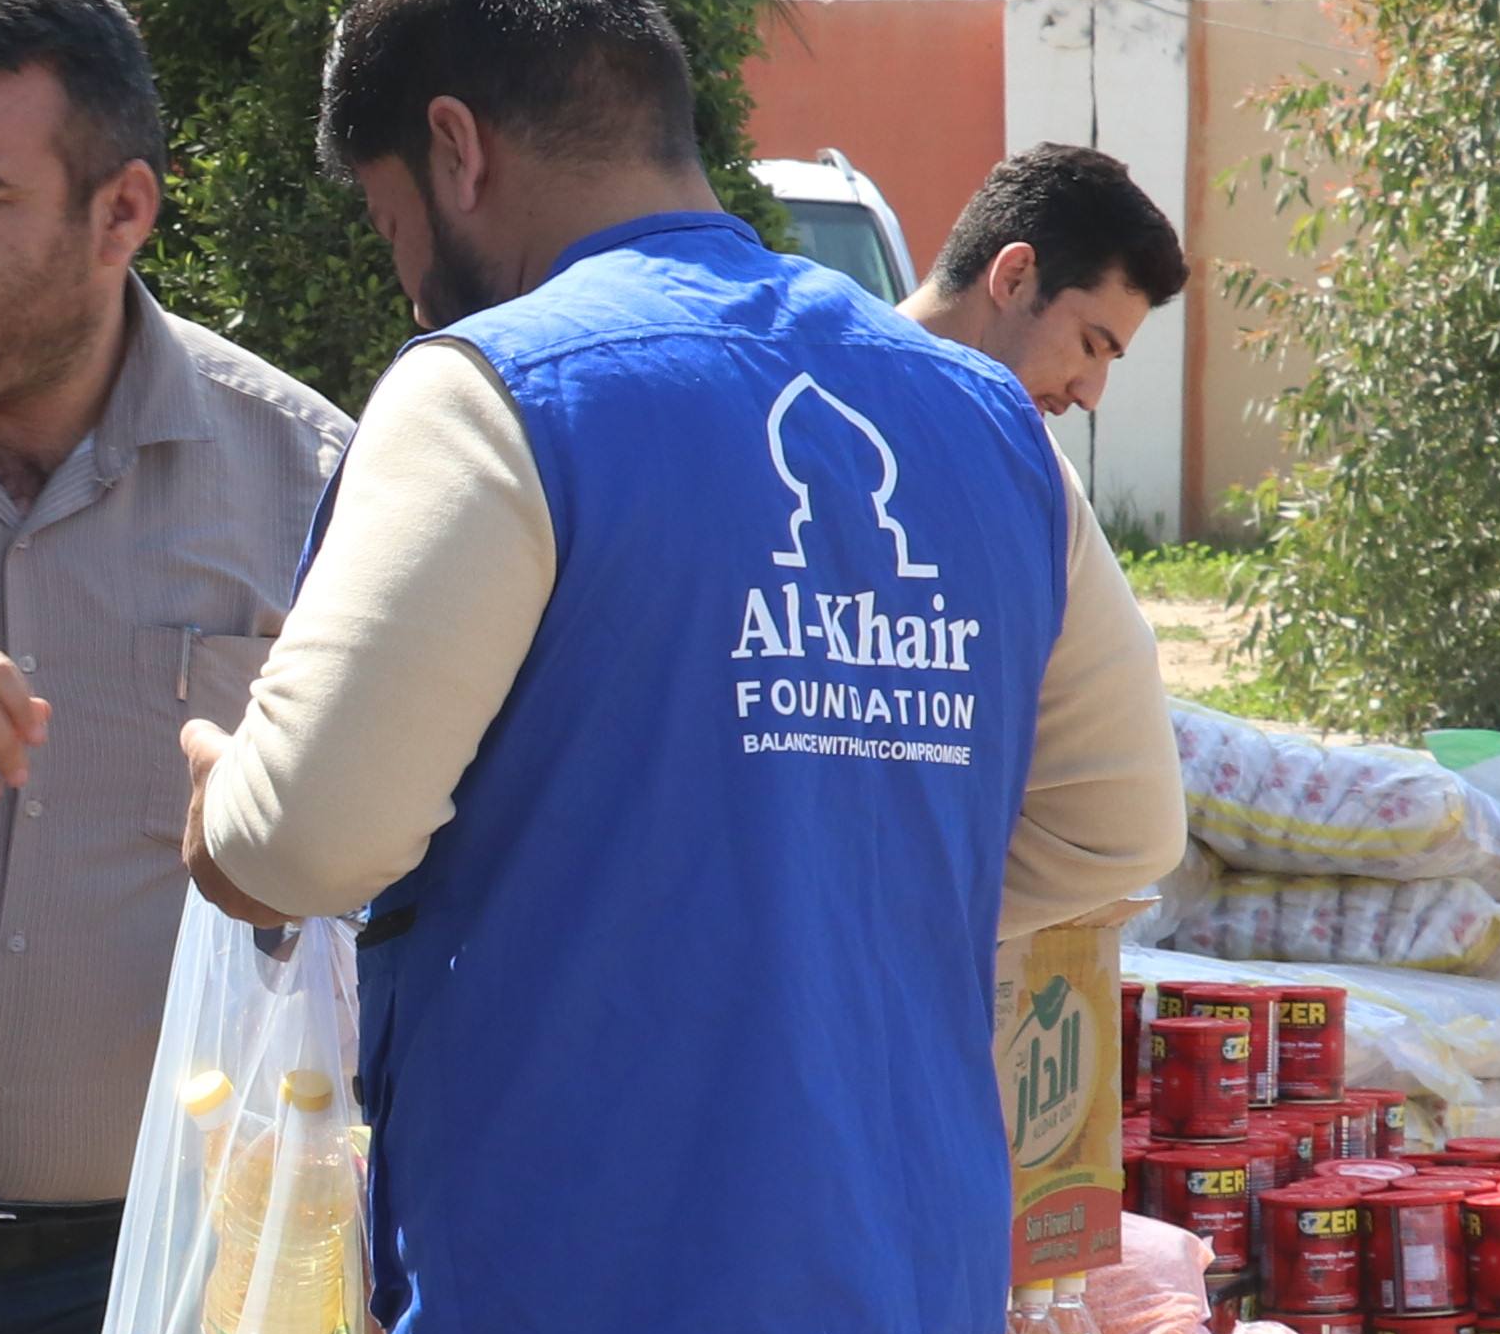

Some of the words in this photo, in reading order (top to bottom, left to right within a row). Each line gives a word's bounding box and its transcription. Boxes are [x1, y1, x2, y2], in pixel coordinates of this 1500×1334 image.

[731, 582, 979, 671] Al-Khair
[737, 678, 974, 729] FOUNDATION
[744, 733, 818, 755] BALANCE
[878, 741, 970, 765] COMPROMISE
[1278, 1002, 1326, 1025] ZER
[1012, 1010, 1081, 1156] الدار
[1204, 1169, 1245, 1195] ZER
[1316, 1209, 1357, 1235] ZER
